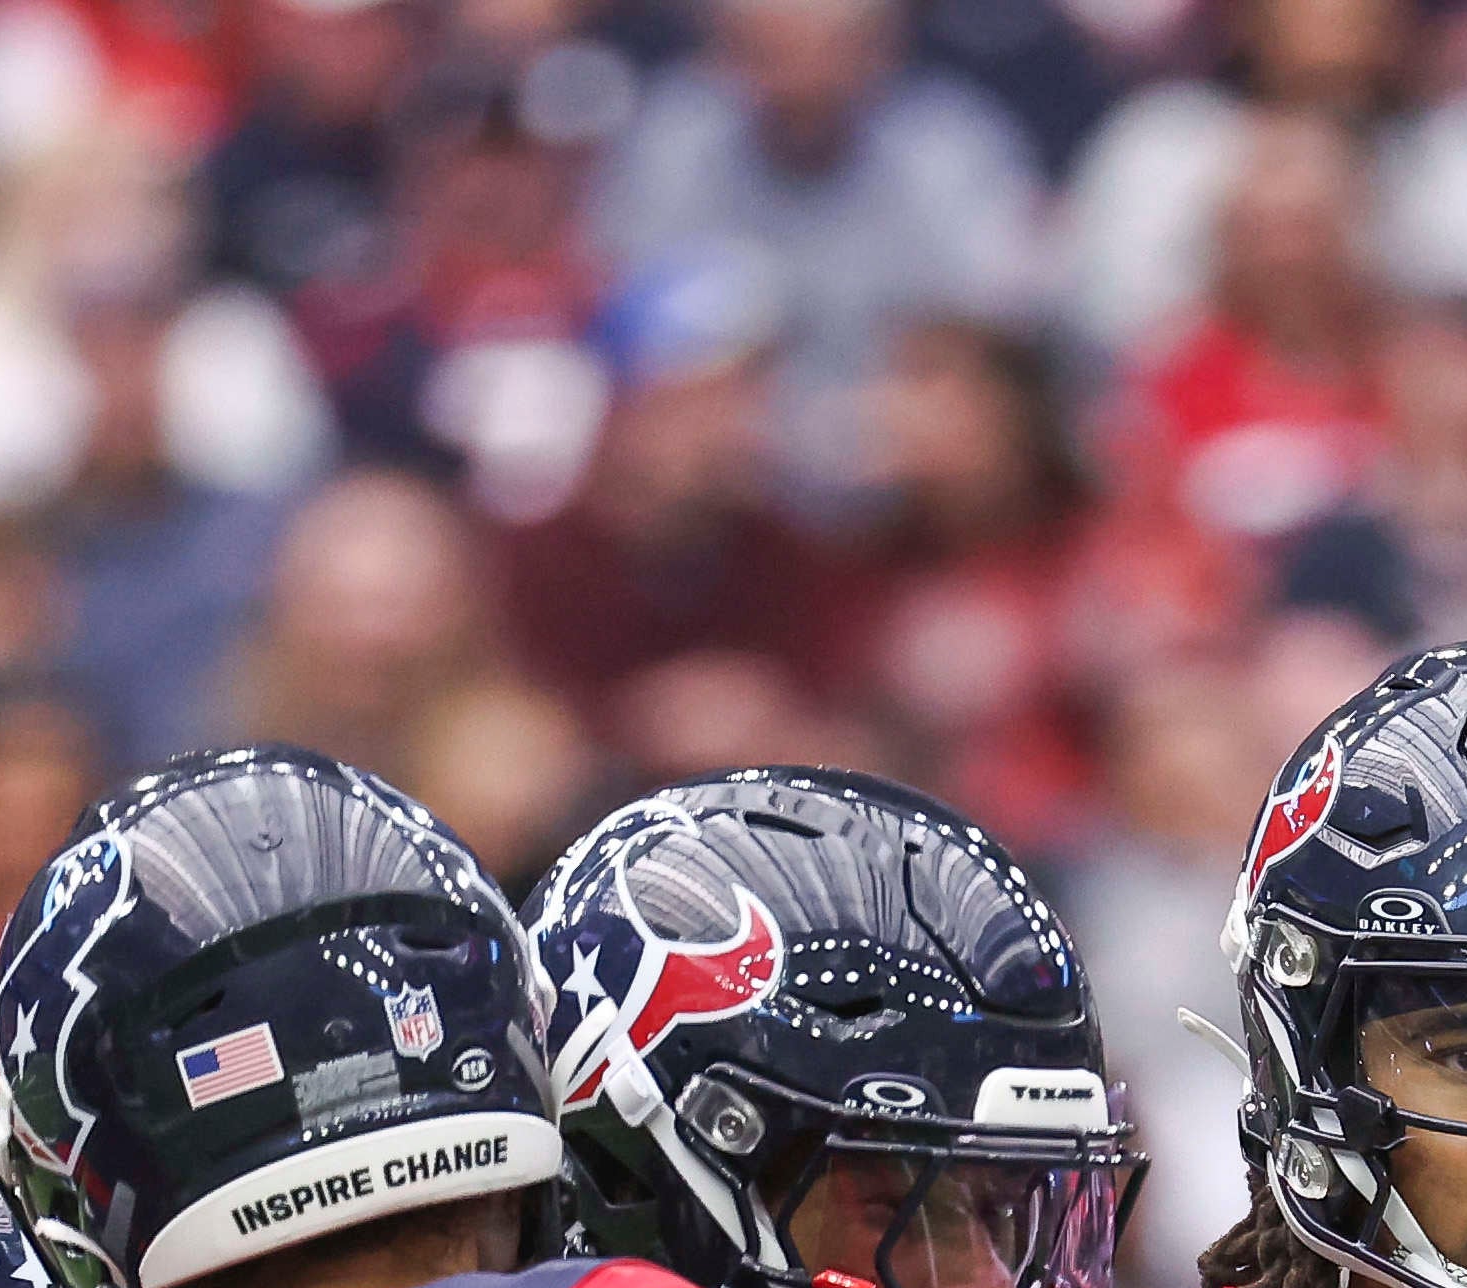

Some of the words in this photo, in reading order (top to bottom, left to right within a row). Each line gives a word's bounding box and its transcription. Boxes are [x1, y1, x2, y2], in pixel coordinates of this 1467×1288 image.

[1359, 918, 1435, 935] OAKLEY
[232, 1166, 374, 1236] INSPIRE
[382, 1135, 509, 1189] CHANGE
